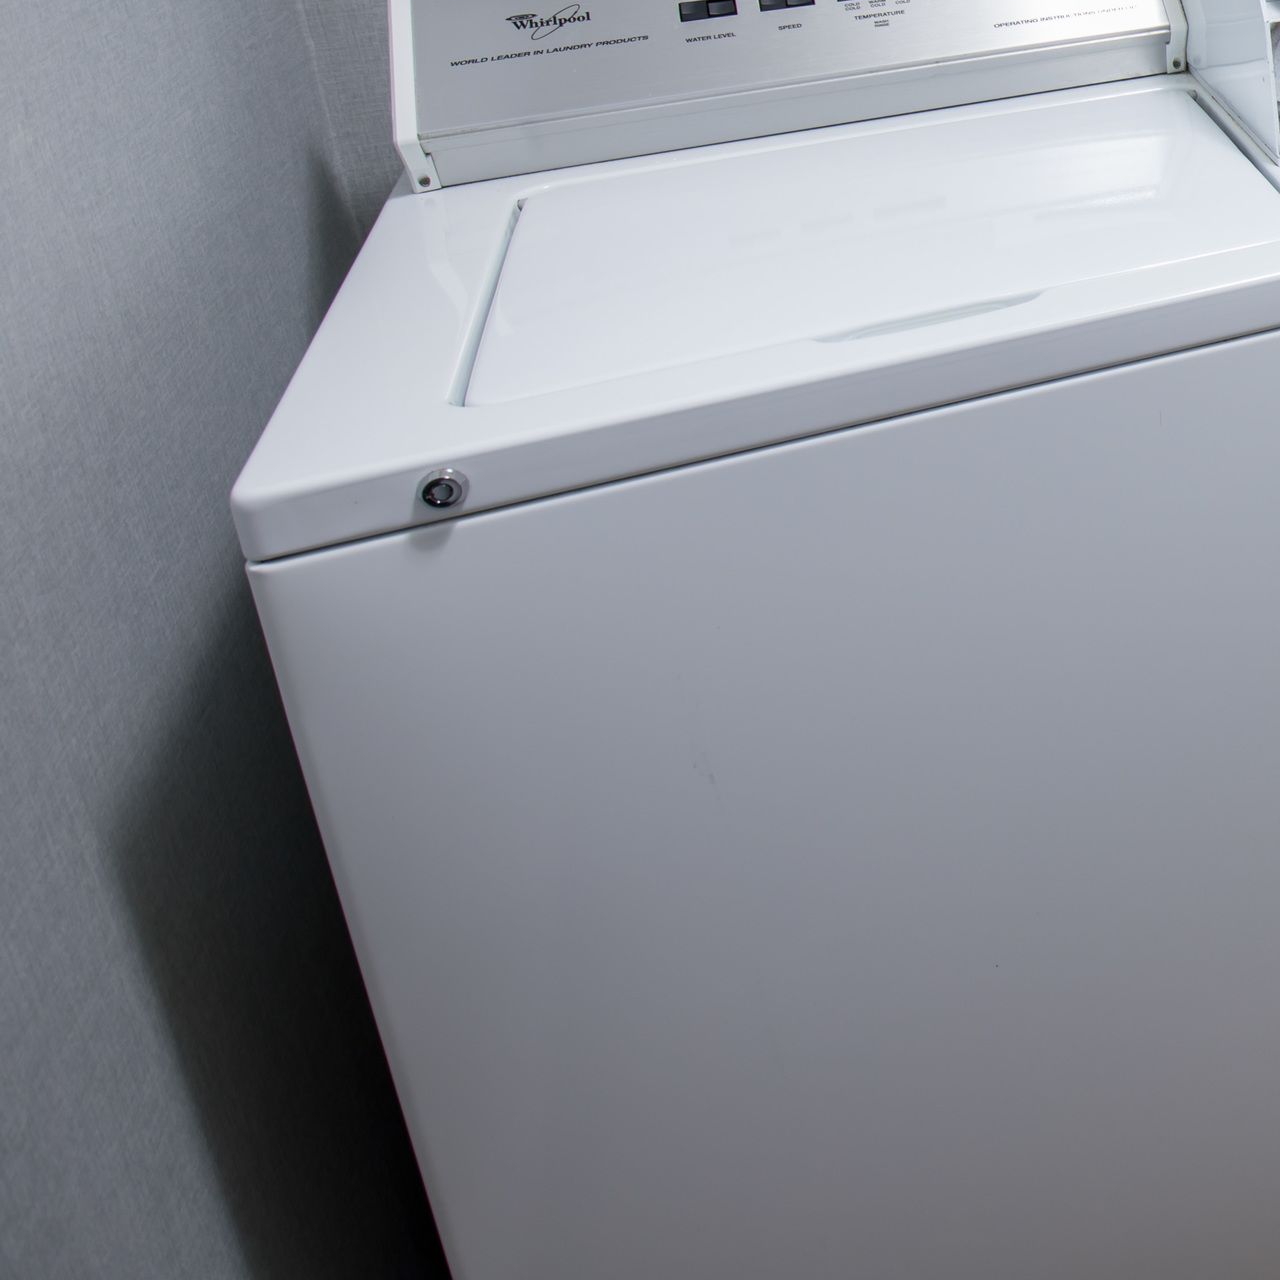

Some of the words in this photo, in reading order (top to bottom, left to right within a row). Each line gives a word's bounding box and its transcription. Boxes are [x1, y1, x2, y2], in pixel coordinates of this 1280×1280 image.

[854, 10, 905, 20] TEMPERATURE
[512, 11, 592, 31] Whirlpool
[993, 18, 1038, 29] OPERATING
[778, 23, 802, 31] SPEED
[685, 34, 712, 43] WATER
[713, 32, 736, 40] LEVEL
[450, 56, 488, 68] WORLD
[491, 51, 531, 62] LEADER
[546, 42, 593, 54] LAUNDRY
[595, 35, 649, 47] PRODUCTS
